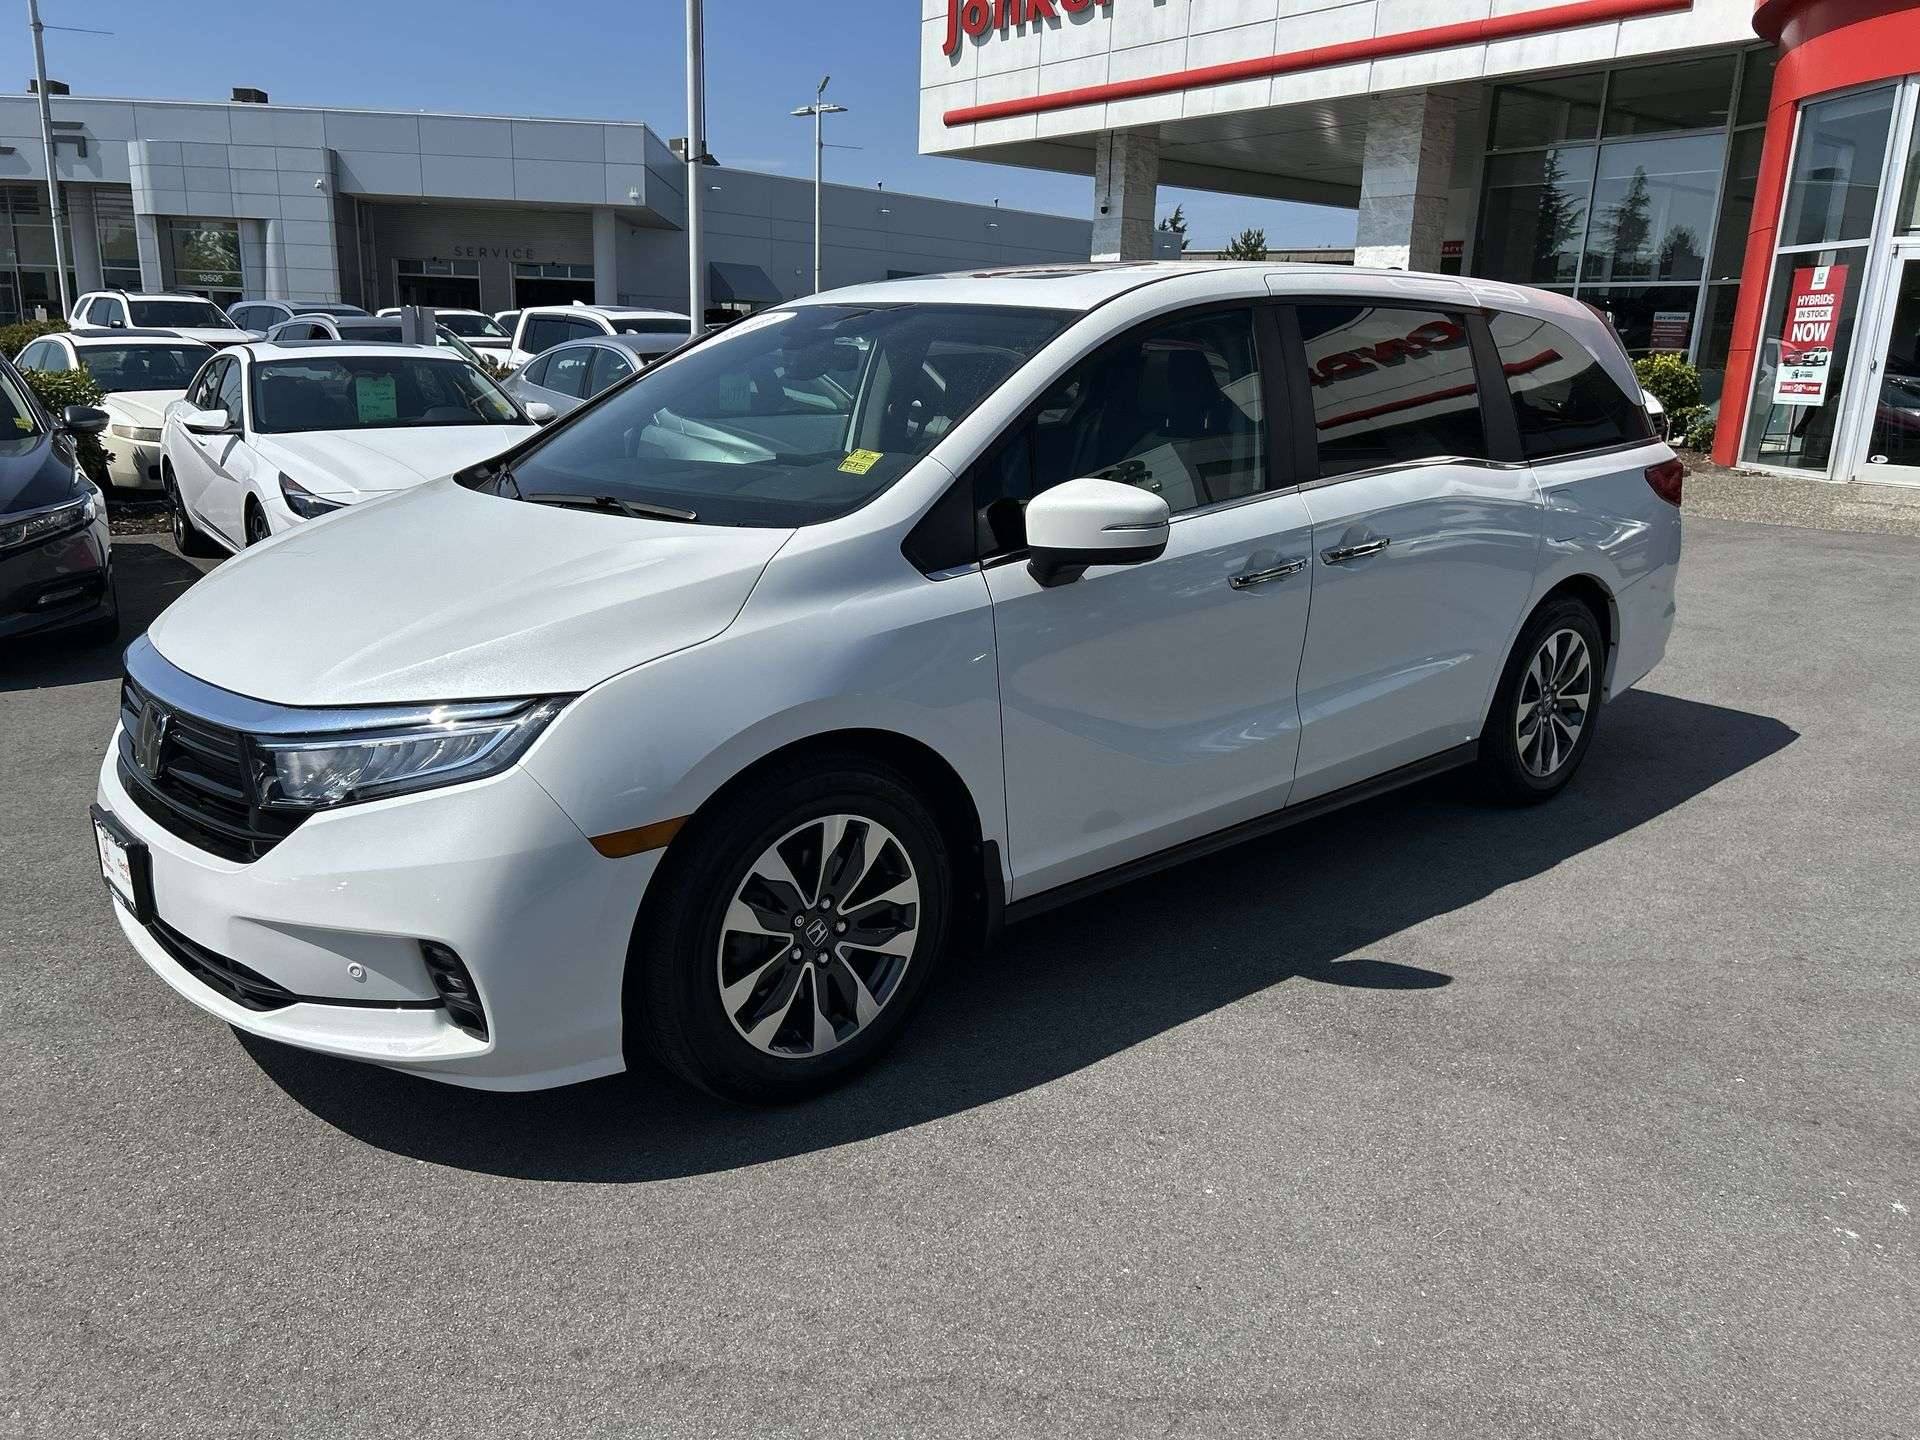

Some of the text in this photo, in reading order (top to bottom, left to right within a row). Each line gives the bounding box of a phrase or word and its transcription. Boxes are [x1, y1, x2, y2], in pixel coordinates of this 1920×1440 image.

[454, 246, 535, 259] SERVICE
[199, 274, 224, 283] 19505
[1797, 294, 1835, 306] HYBRIDS
[1798, 308, 1829, 319] IN STOCK
[1791, 323, 1830, 342] NOW
